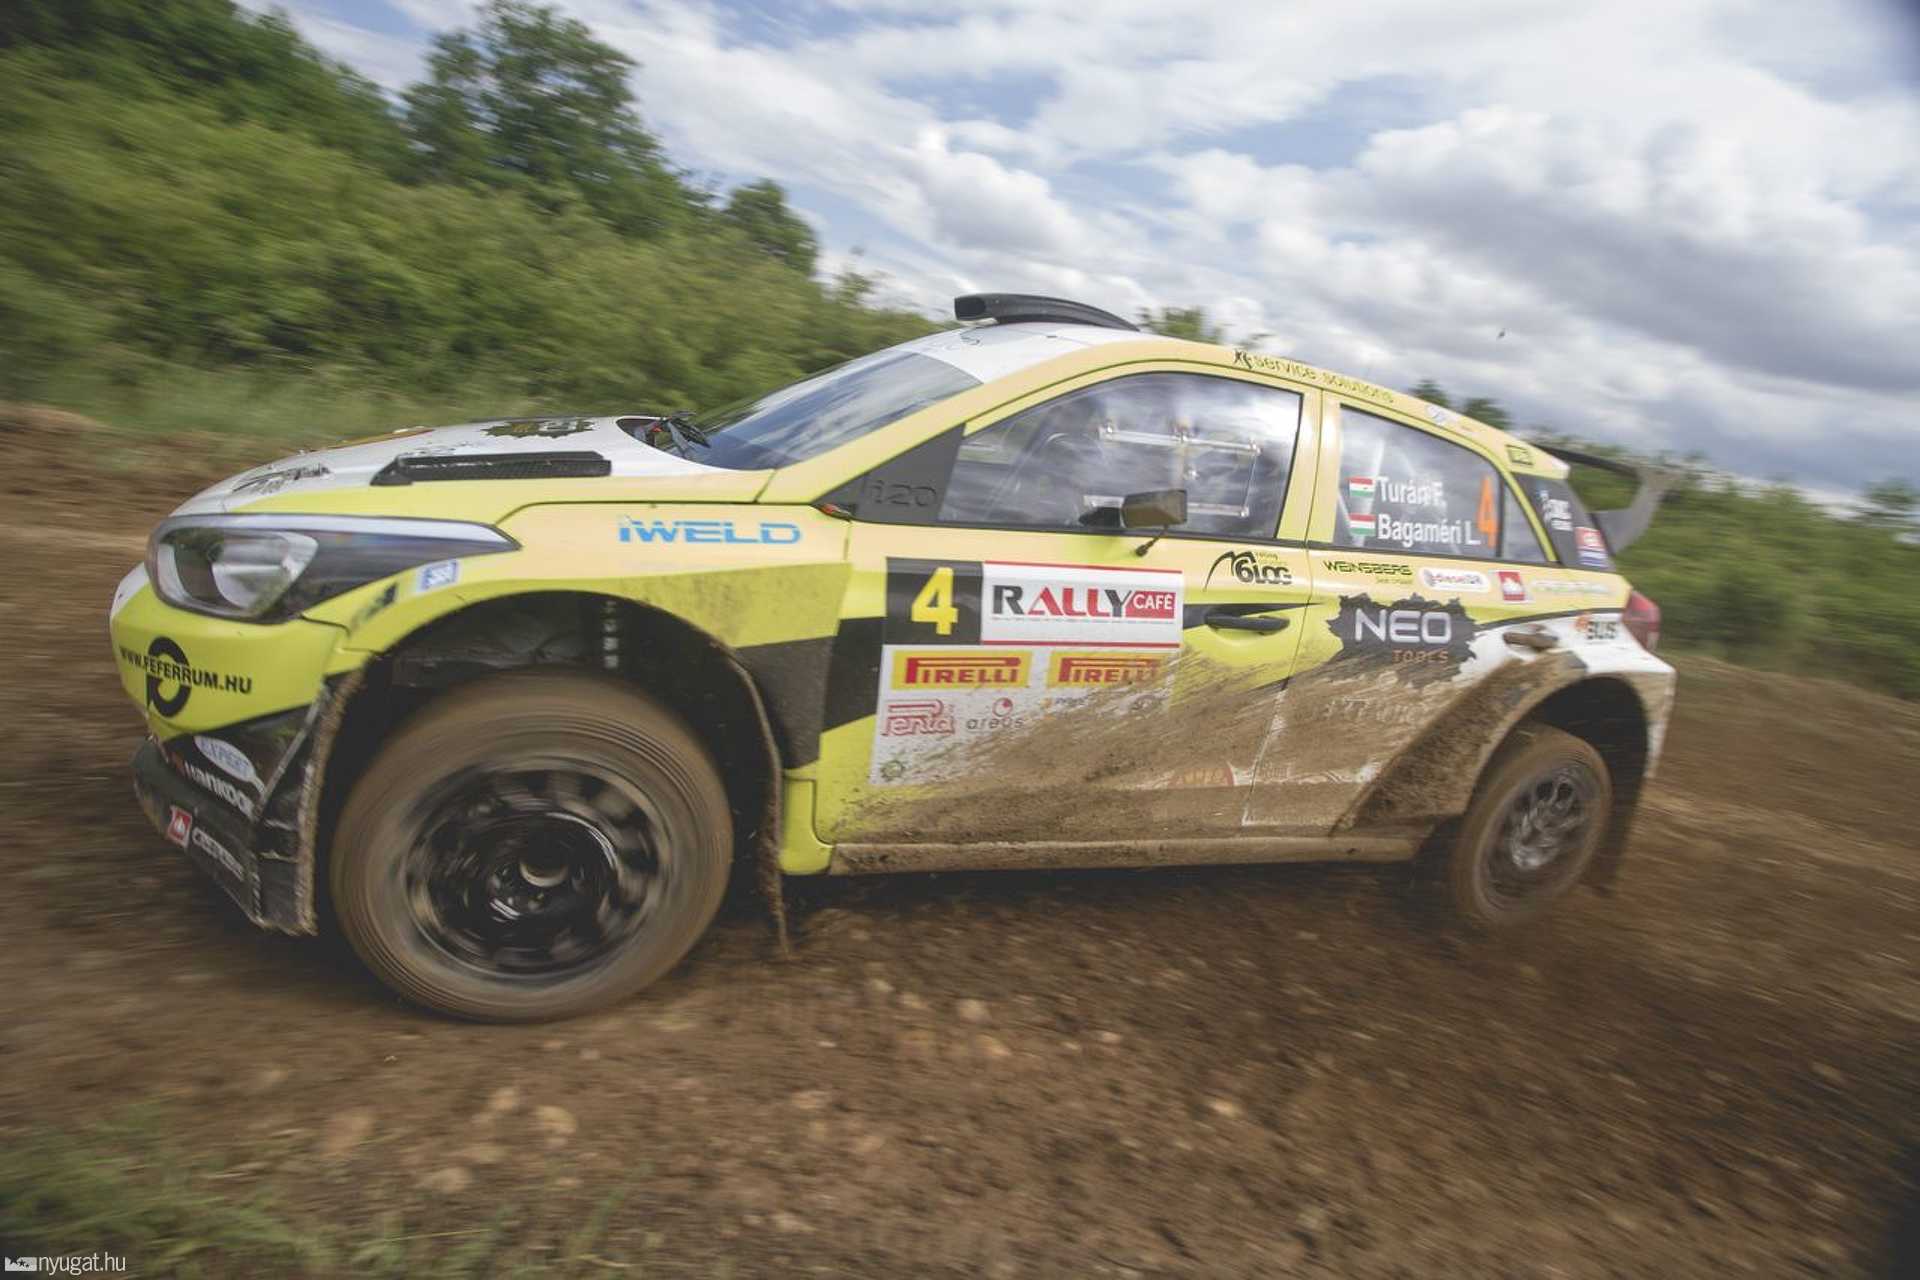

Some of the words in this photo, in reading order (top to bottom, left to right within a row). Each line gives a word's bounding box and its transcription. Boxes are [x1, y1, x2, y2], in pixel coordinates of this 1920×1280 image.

[1475, 474, 1499, 549] 4
[618, 518, 801, 544] iWELD
[1378, 513, 1462, 548] Bagaméri
[1324, 561, 1413, 576] WEINSBERG
[911, 566, 959, 636] 4
[992, 584, 1133, 619] RALLY
[1132, 593, 1174, 611] CAFÉ
[1355, 609, 1452, 645] NEO
[904, 656, 1021, 684] PIRELLI
